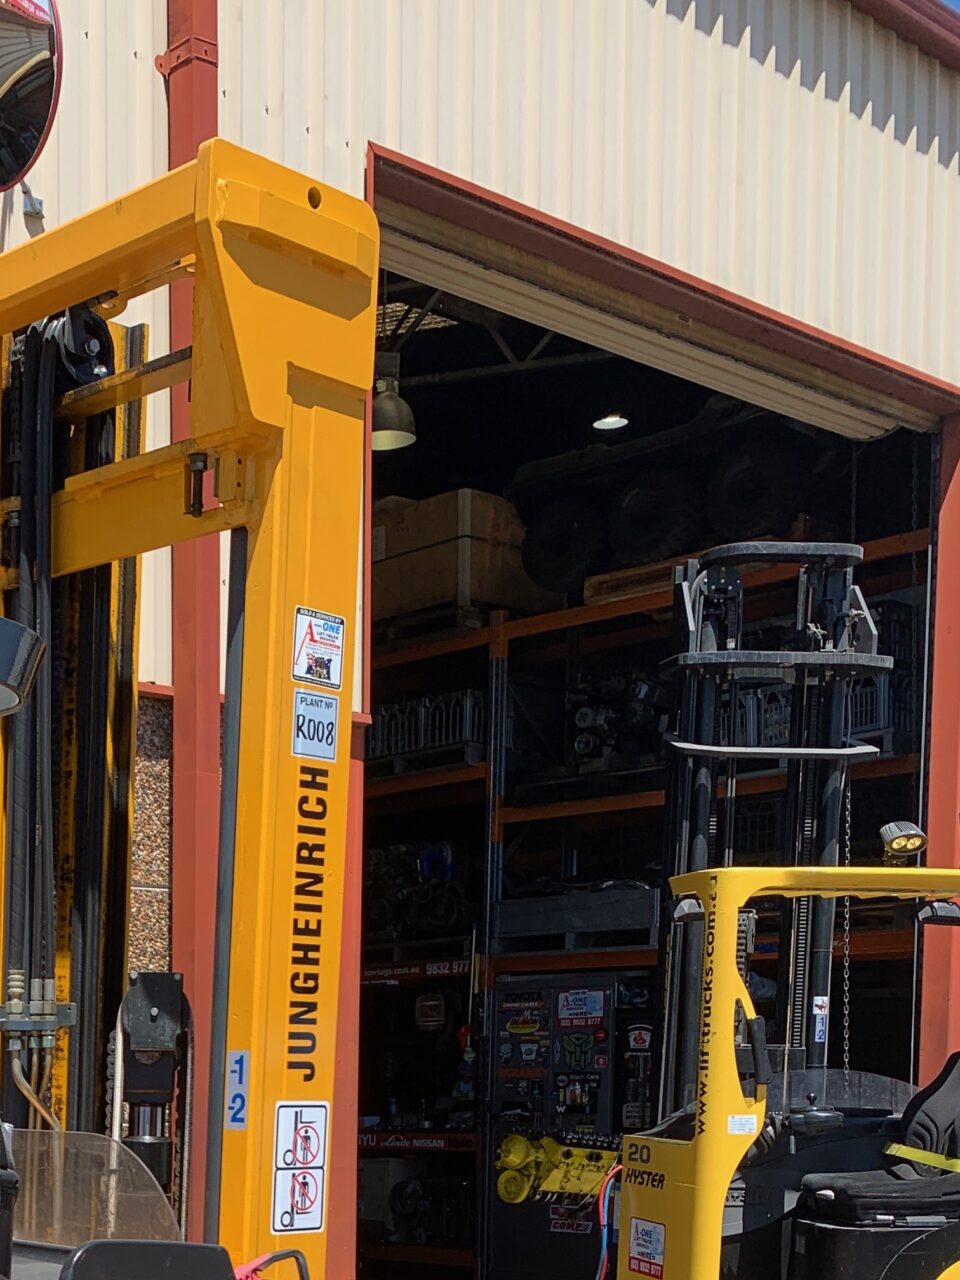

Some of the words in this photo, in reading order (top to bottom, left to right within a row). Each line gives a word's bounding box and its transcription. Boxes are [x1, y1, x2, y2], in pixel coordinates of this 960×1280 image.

[300, 696, 324, 710] PLANT
[296, 713, 335, 747] R008
[286, 765, 329, 1082] JUNGHEINRICH
[426, 961, 450, 975] 9832
[504, 991, 543, 1002] TOYOTA
[412, 1138, 445, 1148] NISSAN
[627, 1143, 651, 1165] 20
[624, 1167, 666, 1191] HYSTER
